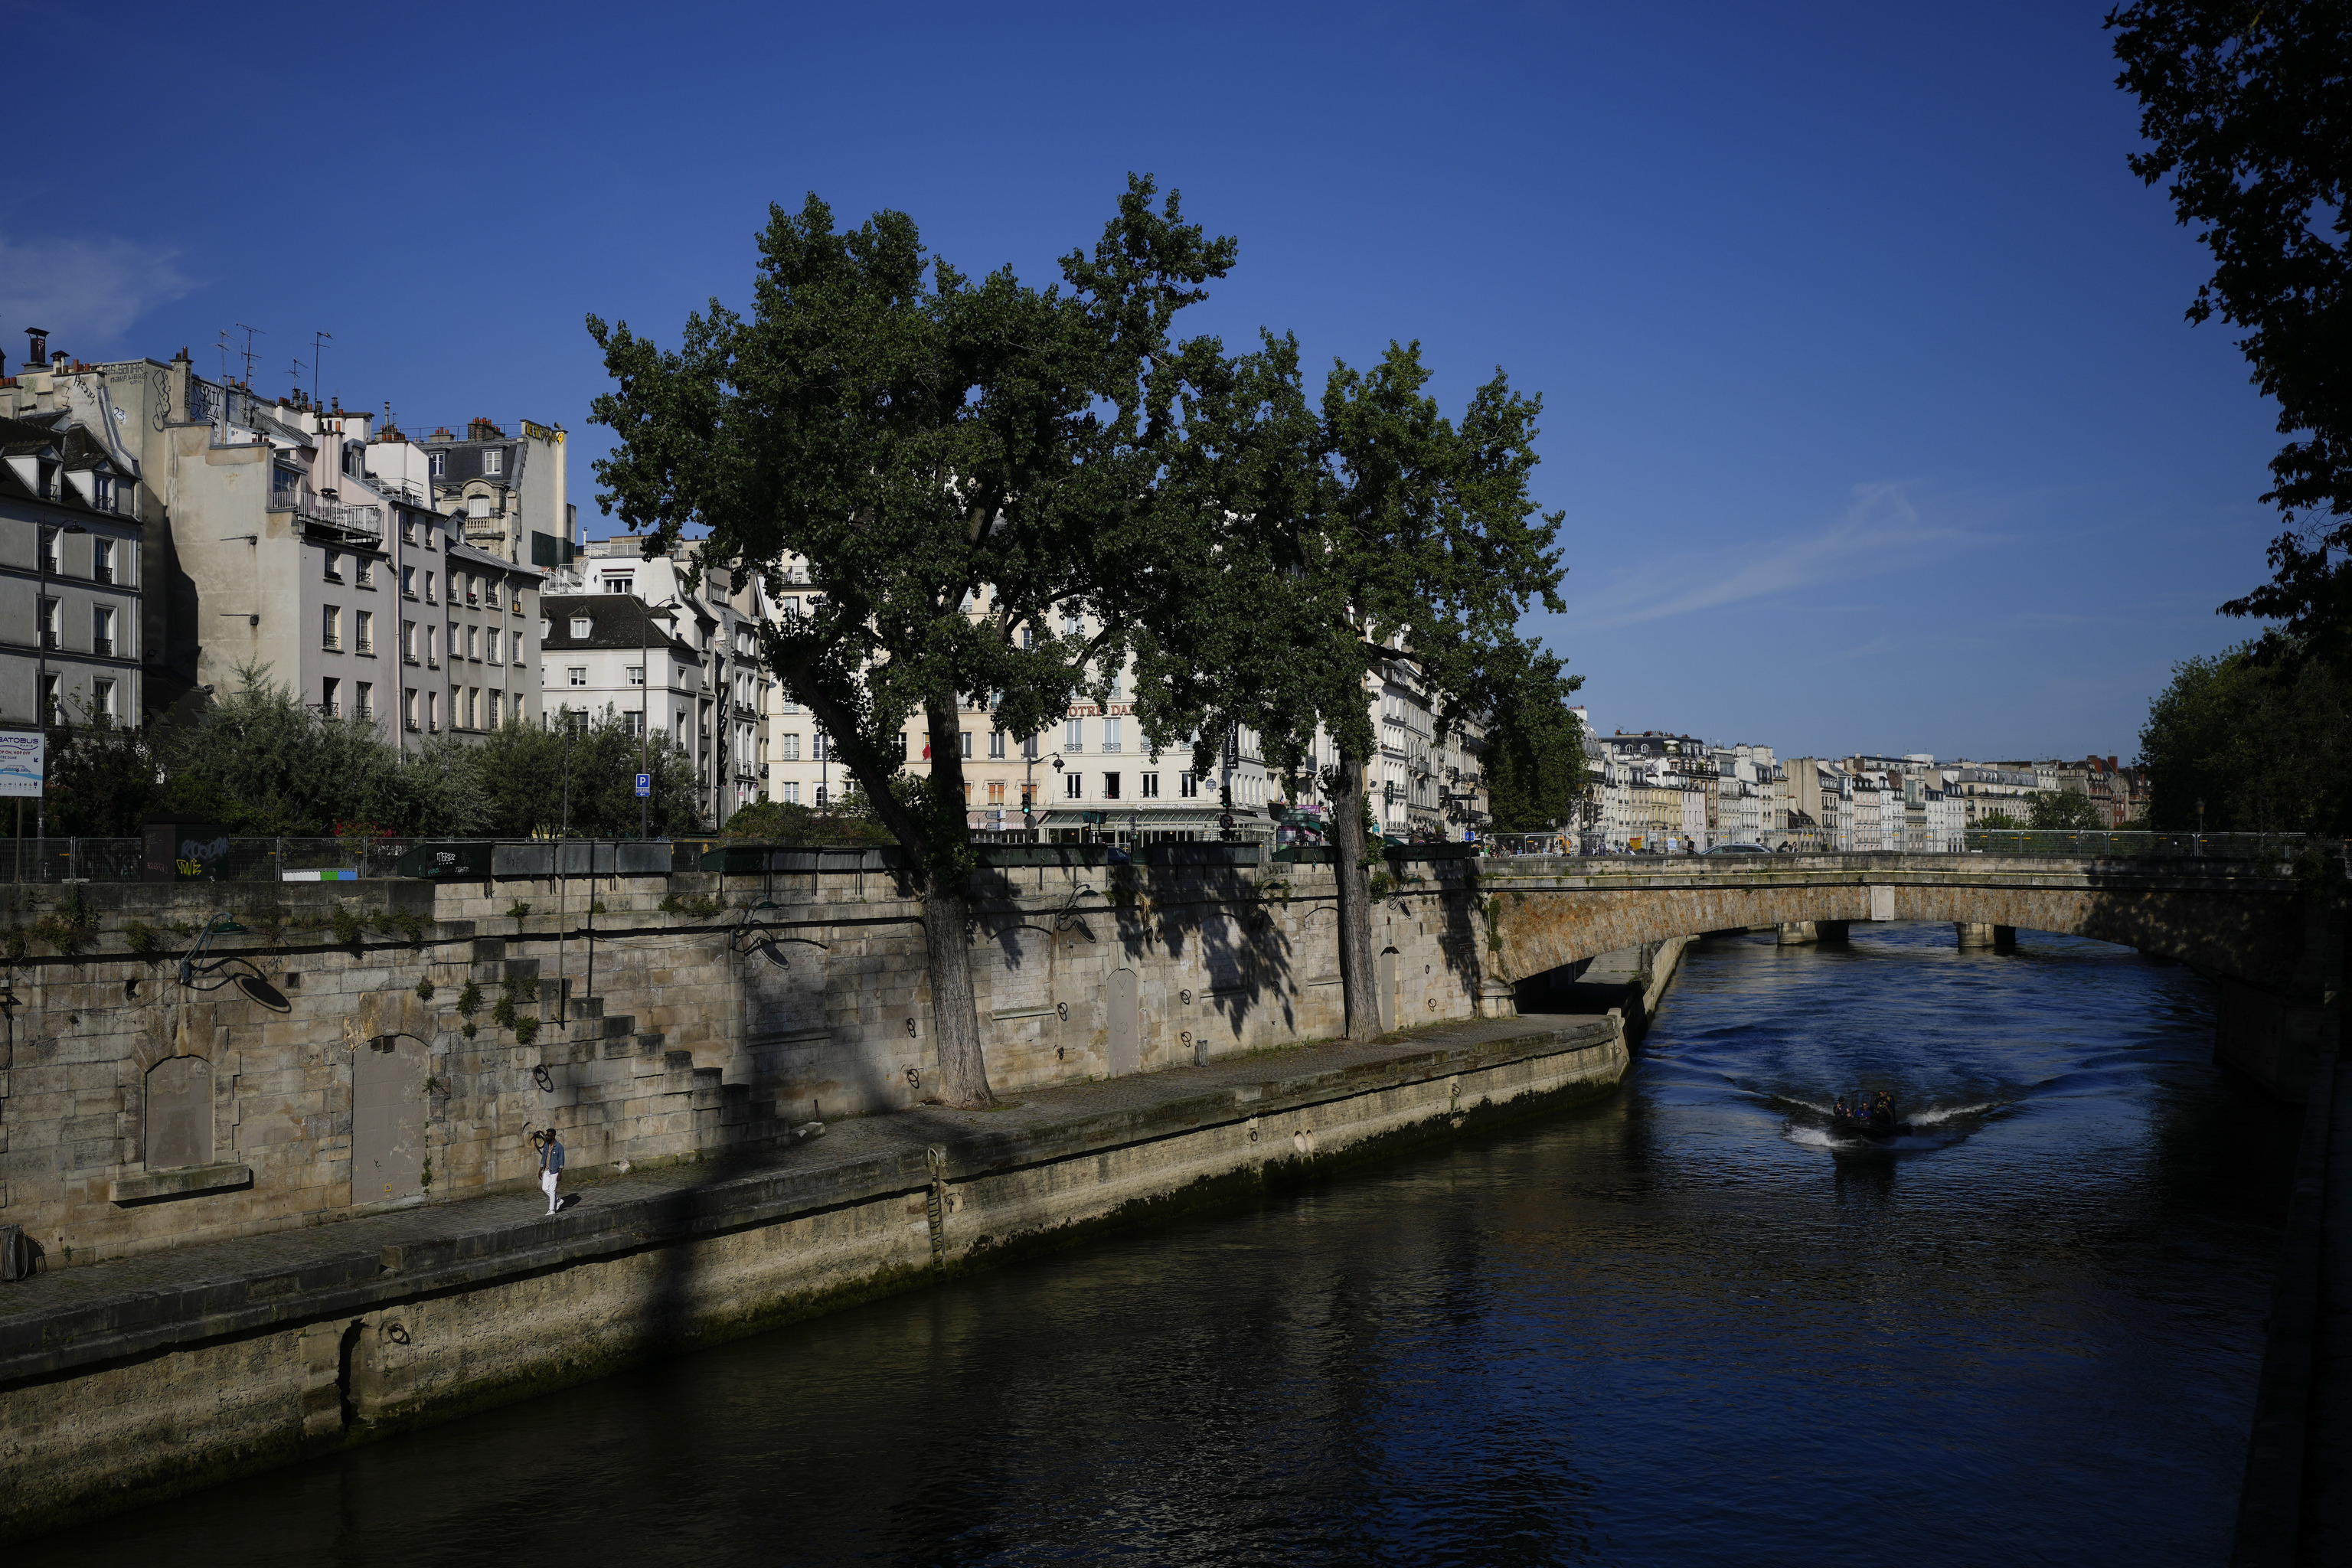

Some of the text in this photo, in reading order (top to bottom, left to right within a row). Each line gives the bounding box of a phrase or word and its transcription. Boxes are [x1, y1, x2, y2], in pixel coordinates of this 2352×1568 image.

[1069, 704, 1132, 717] OTR DA
[640, 776, 646, 786] P
